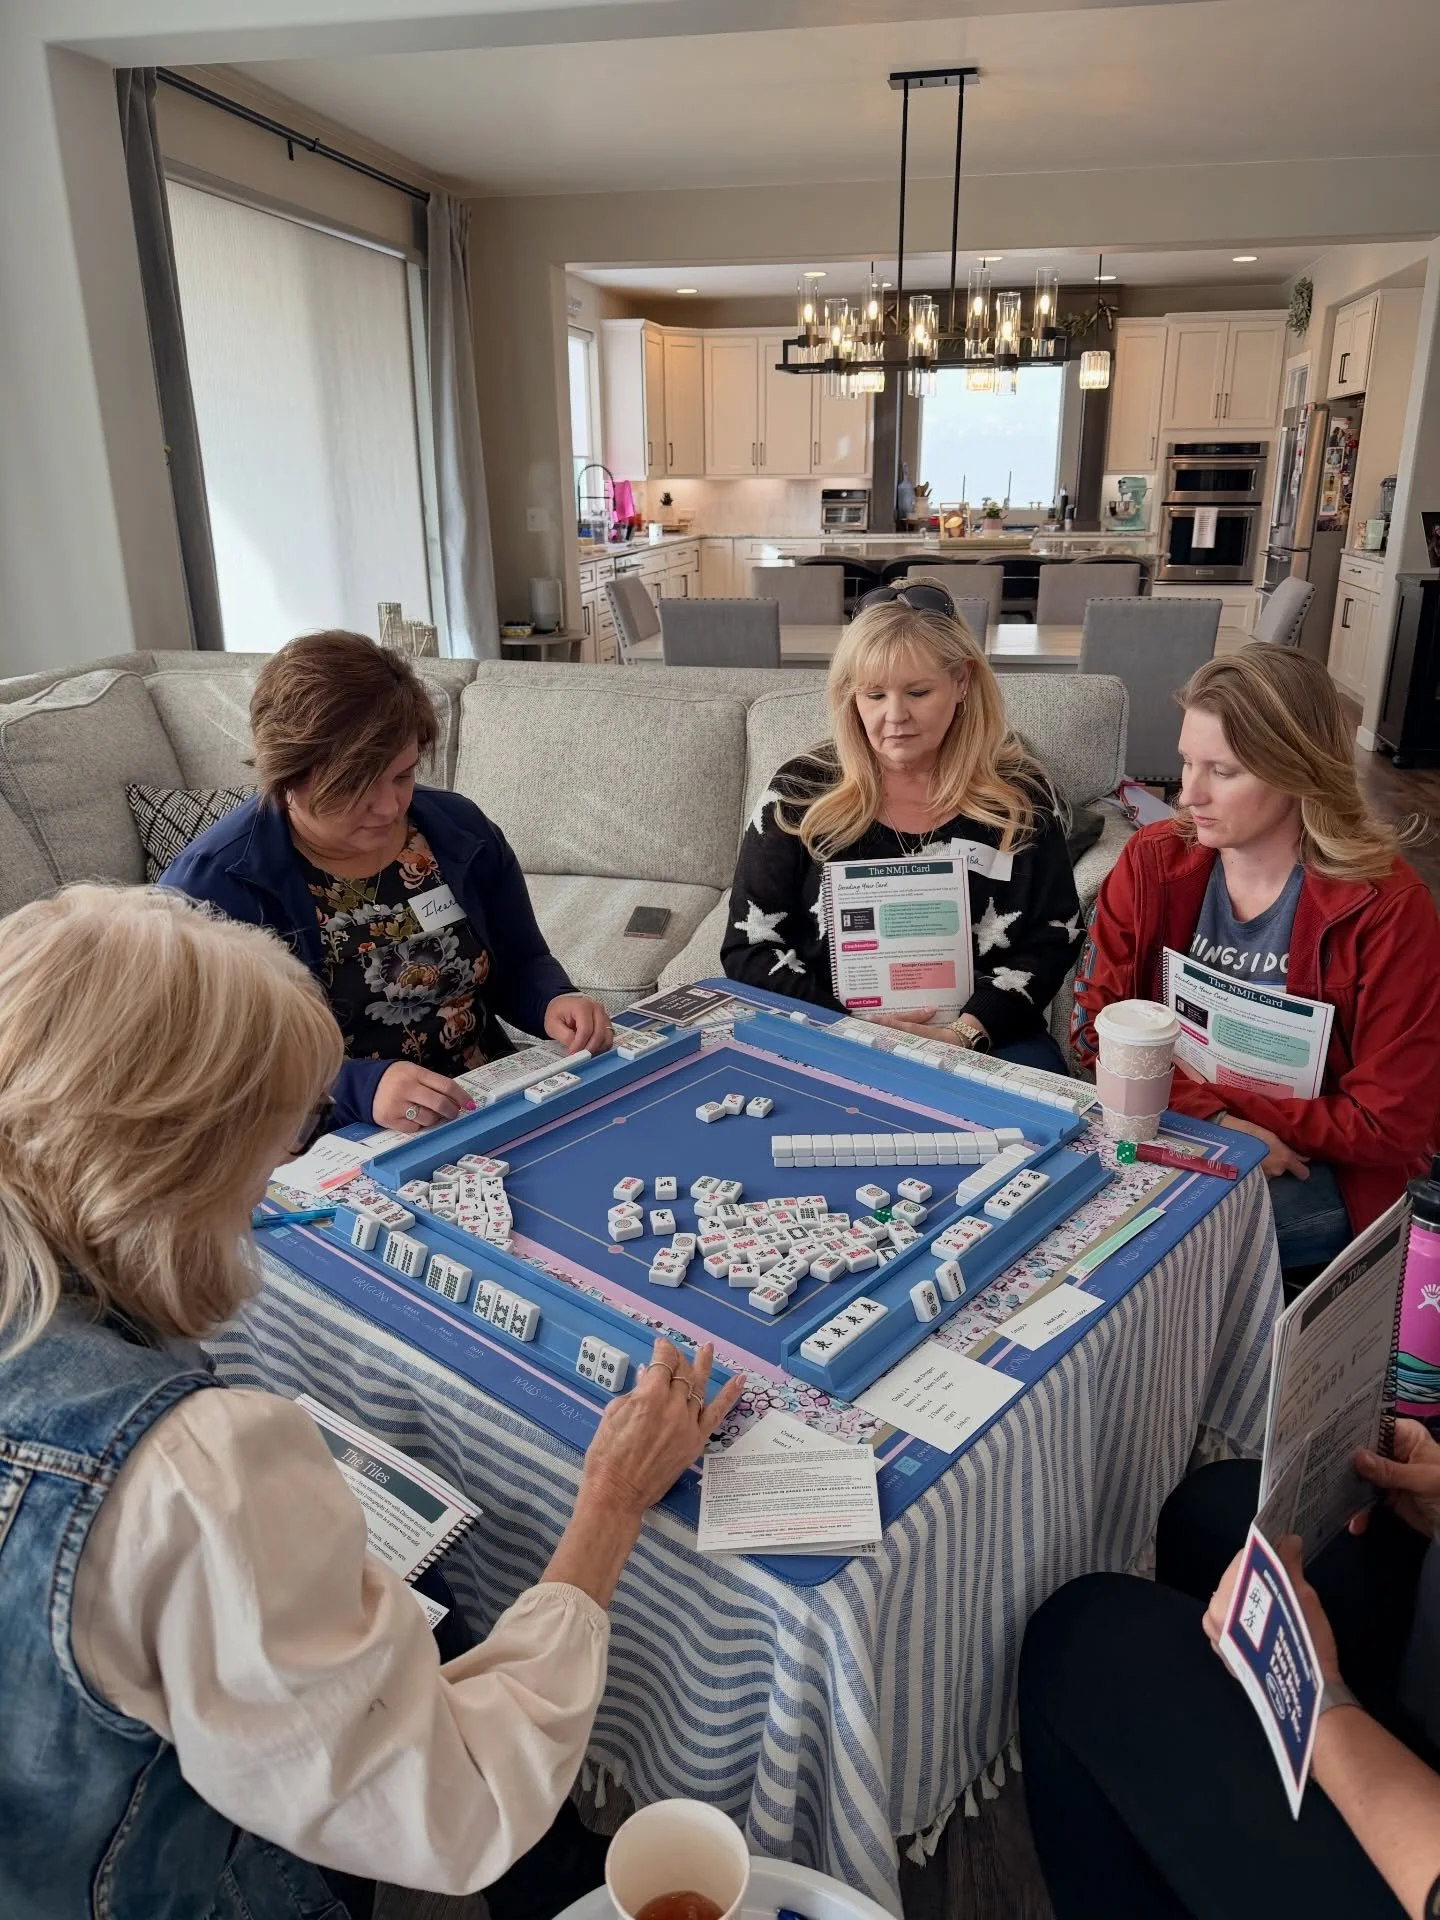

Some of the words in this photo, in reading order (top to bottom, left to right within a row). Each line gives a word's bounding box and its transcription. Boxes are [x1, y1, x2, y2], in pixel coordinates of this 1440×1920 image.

[868, 867, 885, 876] The
[886, 865, 910, 875] NMJL
[911, 864, 930, 873] Card
[861, 882, 874, 890] Your
[1199, 985, 1213, 997] Your
[1213, 992, 1229, 1002] Card
[1208, 976, 1226, 990] The
[1227, 984, 1258, 1001] NMJL
[1259, 994, 1283, 1008] Card
[582, 1341, 588, 1349] 4
[341, 1448, 363, 1470] The
[362, 1459, 390, 1485] Tiles
[399, 1509, 416, 1523] Chinese
[425, 1529, 435, 1538] and
[382, 1540, 401, 1555] Modern
